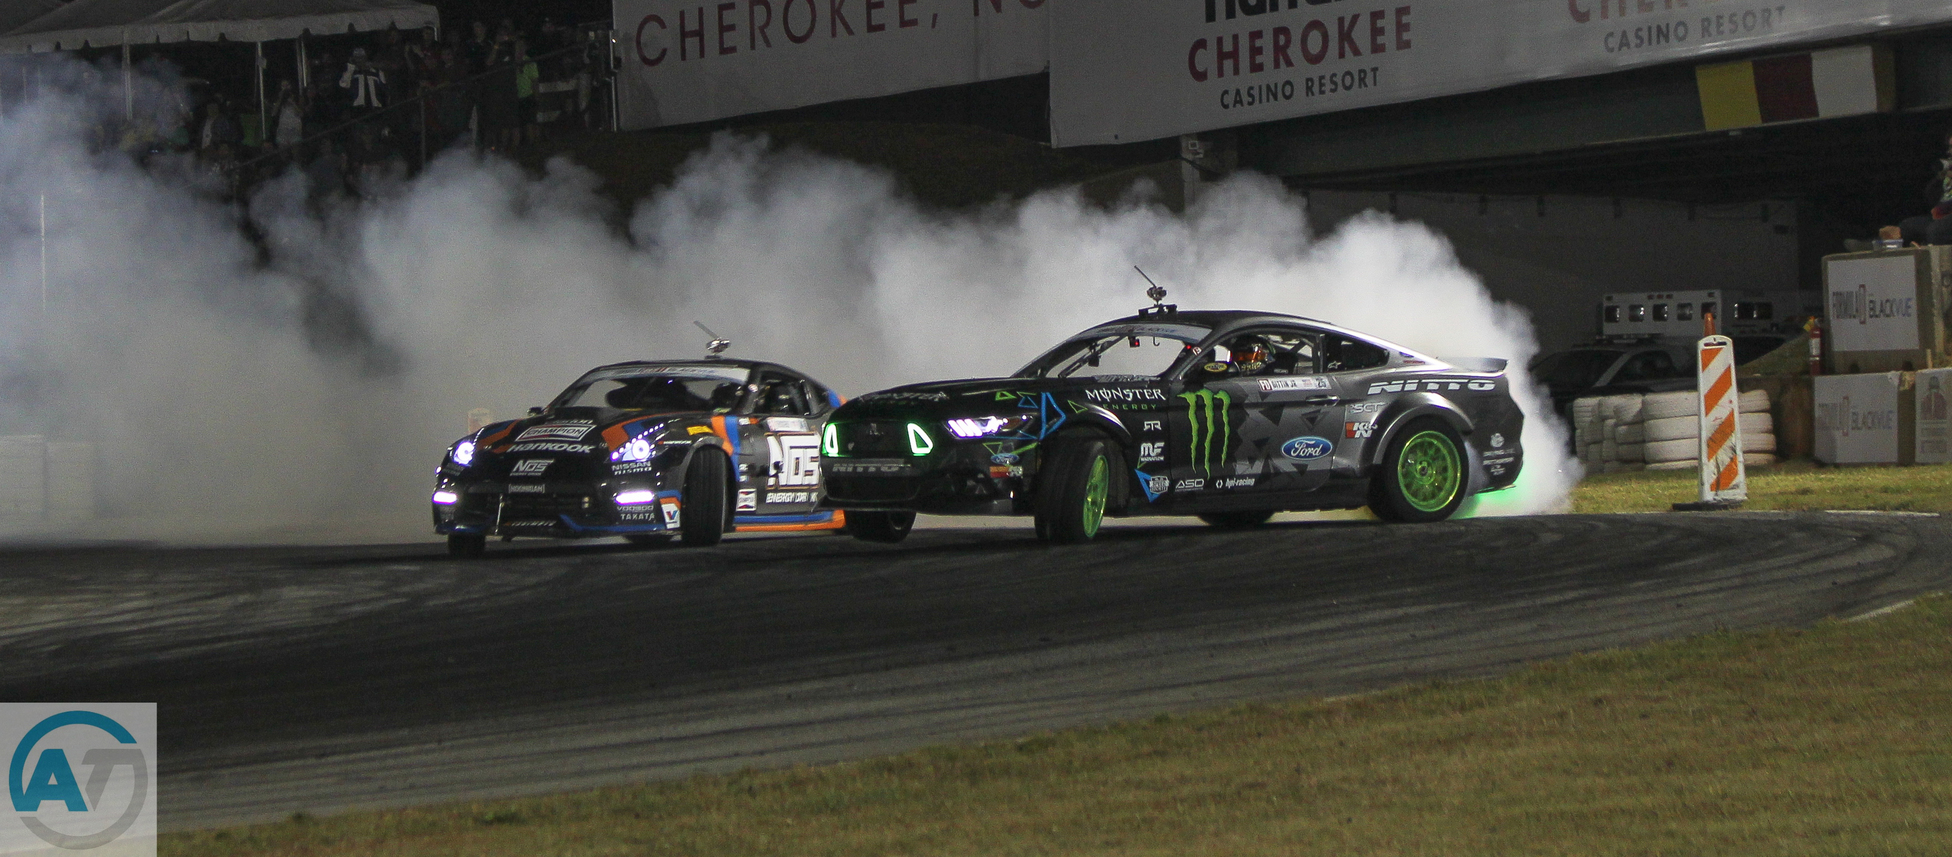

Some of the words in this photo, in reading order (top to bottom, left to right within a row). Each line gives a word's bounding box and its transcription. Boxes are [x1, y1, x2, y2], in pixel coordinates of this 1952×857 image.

[1604, 20, 1689, 53] CASINO
[1701, 5, 1787, 39] RESORT
[1188, 5, 1413, 83] CHEROKEE
[1220, 79, 1295, 110] CASINO
[1305, 66, 1379, 97] RESORT
[1367, 379, 1496, 396] NITTO
[1291, 440, 1325, 457] Ford
[512, 459, 555, 472] NOS
[611, 461, 652, 472] NISSAN
[766, 432, 821, 487] NOS
[620, 513, 655, 521] TAKATA
